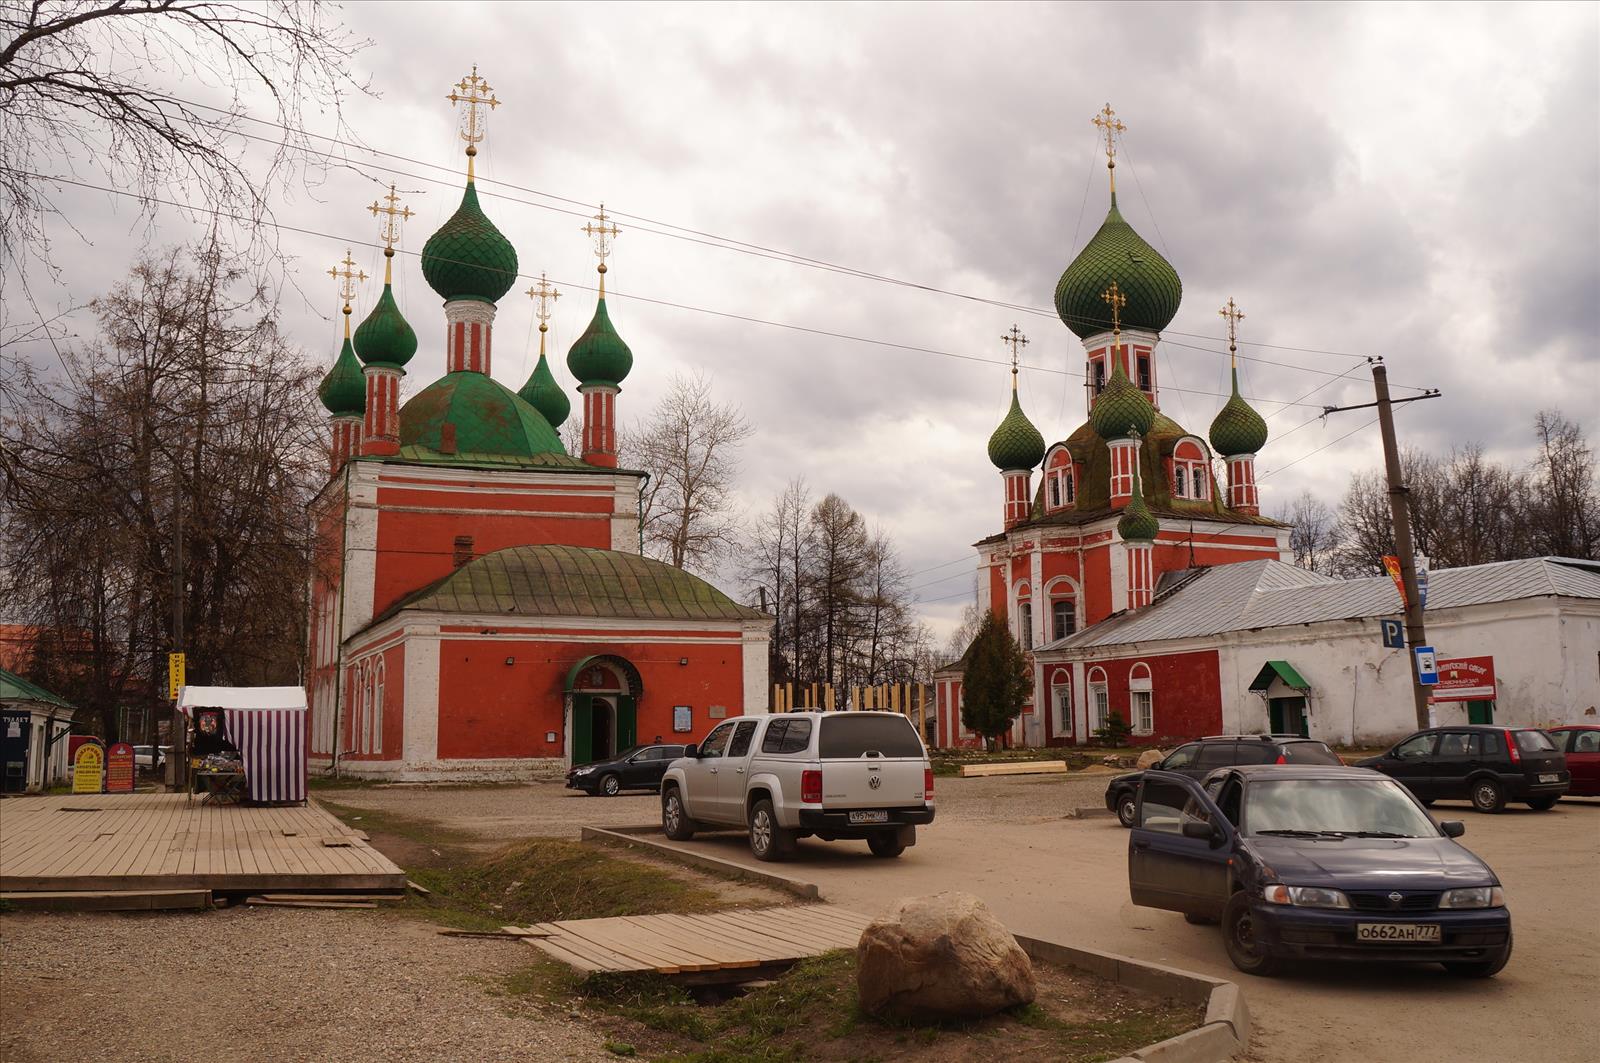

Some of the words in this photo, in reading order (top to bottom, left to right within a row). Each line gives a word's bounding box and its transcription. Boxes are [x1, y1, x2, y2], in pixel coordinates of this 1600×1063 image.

[1386, 622, 1398, 645] P
[1361, 925, 1415, 939] О662АН
[1416, 925, 1437, 936] 777
